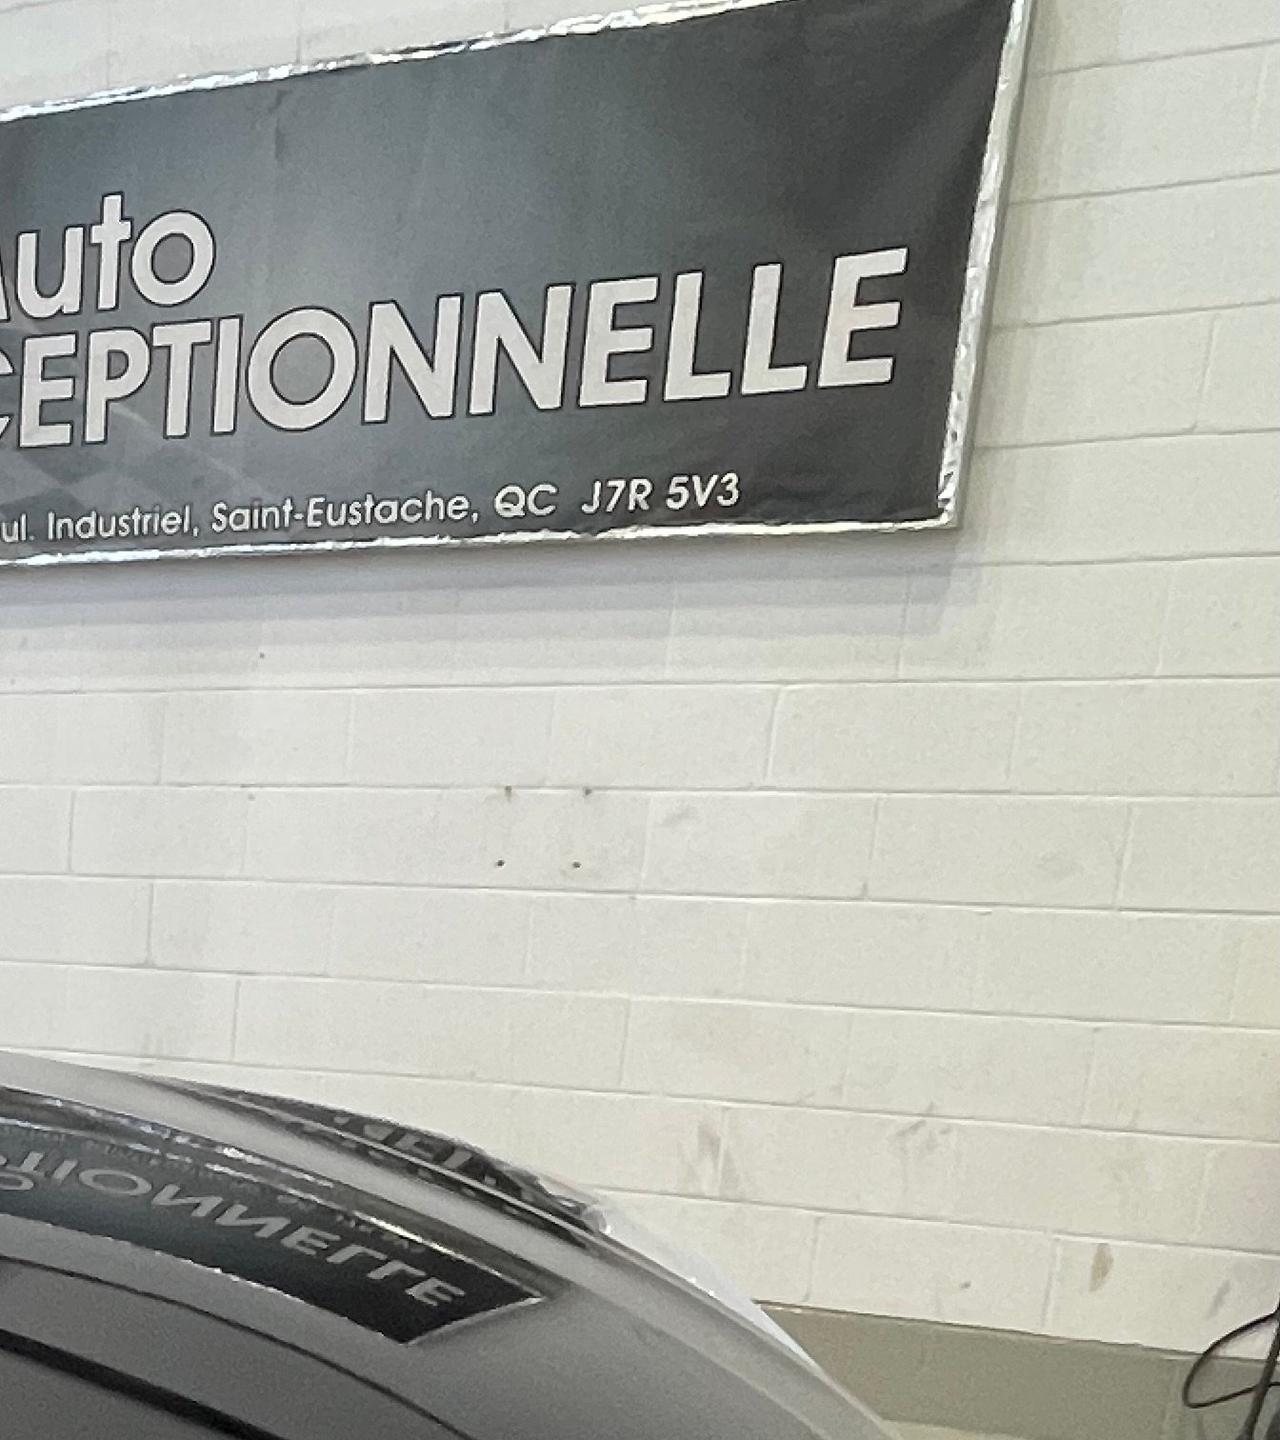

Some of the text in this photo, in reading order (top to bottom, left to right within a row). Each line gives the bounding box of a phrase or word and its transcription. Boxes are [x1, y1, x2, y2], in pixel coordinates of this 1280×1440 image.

[47, 504, 200, 541] Industriel,
[210, 489, 479, 533] Saint-Eustache,
[494, 482, 558, 518] QC
[581, 477, 651, 514] J7R
[665, 471, 740, 510] 5V3
